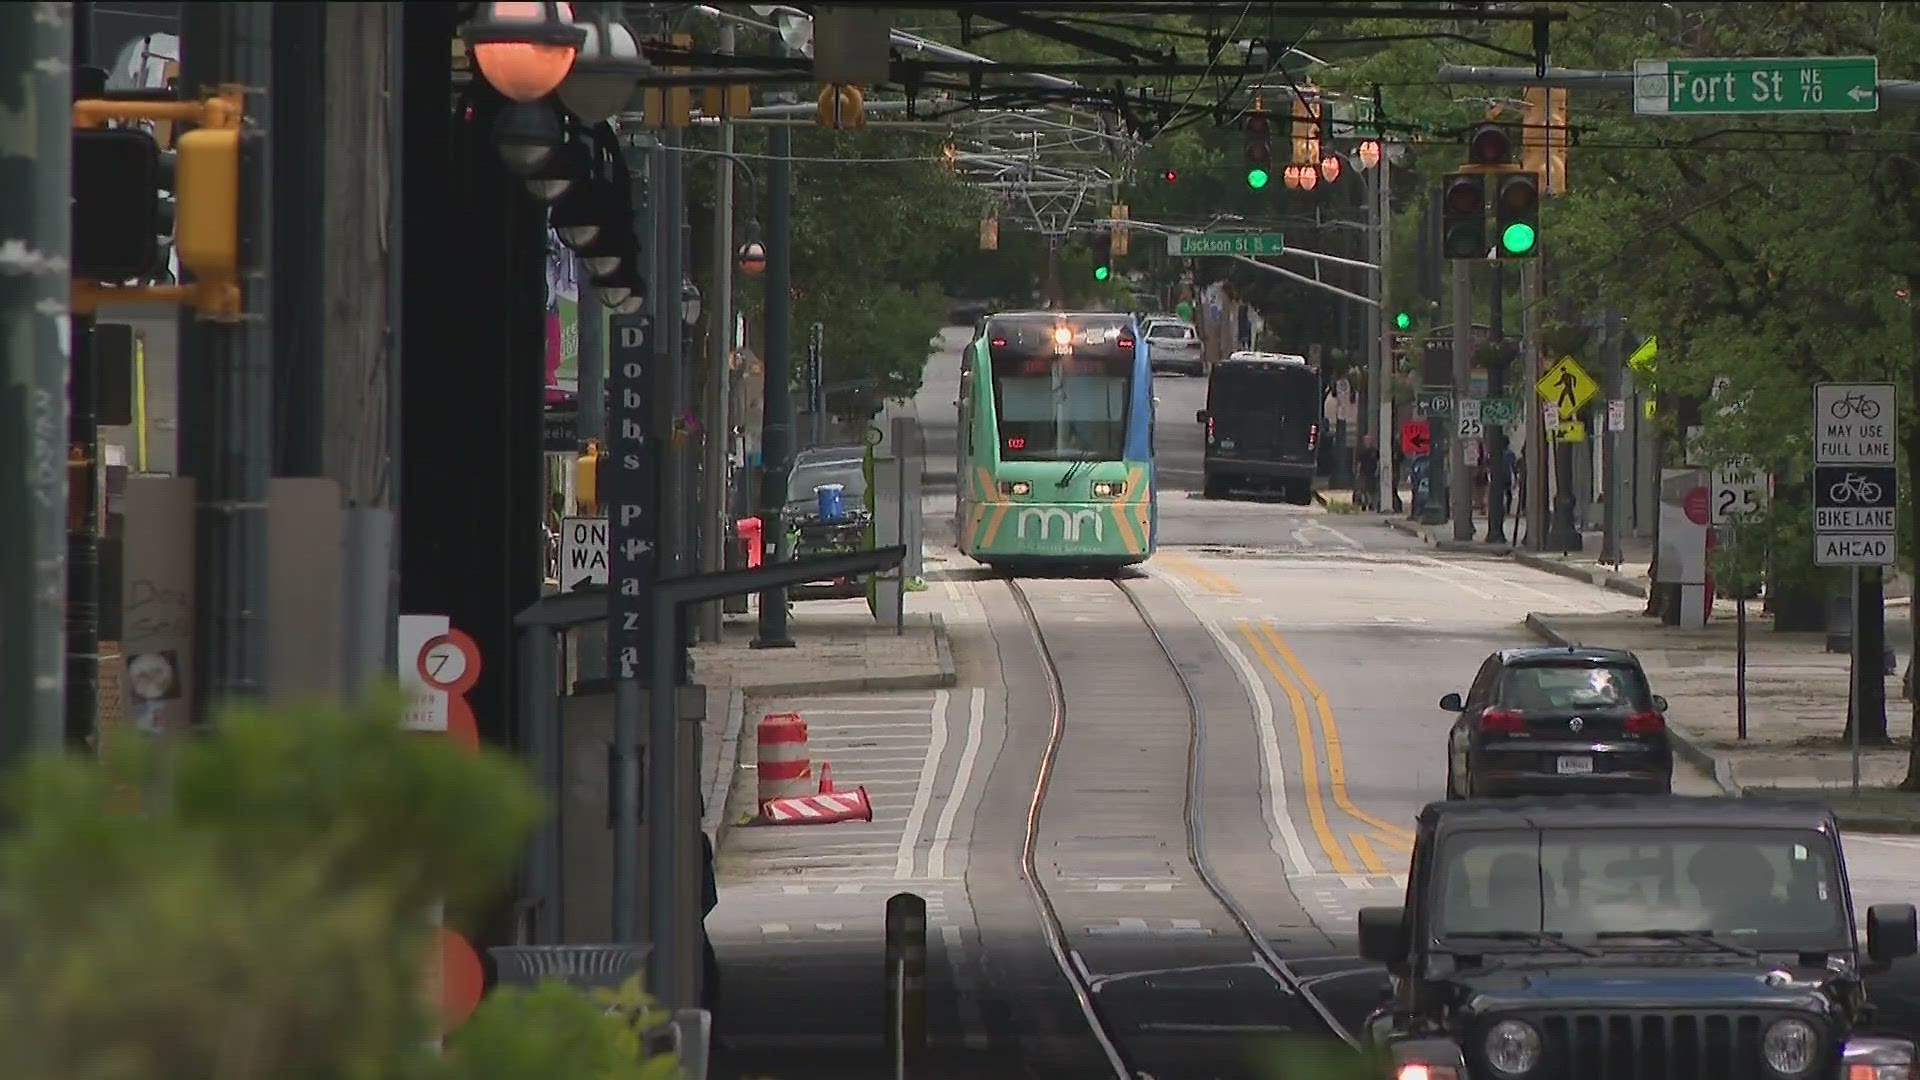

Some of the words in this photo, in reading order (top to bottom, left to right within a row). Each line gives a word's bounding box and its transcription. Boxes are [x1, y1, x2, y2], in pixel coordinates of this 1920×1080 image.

[1800, 69, 1822, 85] NE
[1673, 69, 1736, 103] Fort
[1751, 70, 1784, 102] St
[1801, 85, 1823, 103] 70
[1183, 236, 1231, 252] Jackson
[1235, 237, 1247, 251] St
[1460, 419, 1481, 435] 25
[1828, 425, 1851, 438] MAY
[1860, 425, 1882, 438] USE
[1822, 443, 1850, 456] FULL
[1859, 443, 1889, 456] LANE
[1719, 489, 1760, 516] 25
[1818, 511, 1850, 526] BIKE
[1856, 511, 1892, 526] LANE
[574, 523, 606, 546] ON
[1826, 541, 1886, 556] AHEAD
[571, 549, 607, 570] WA
[430, 654, 449, 677] 7
